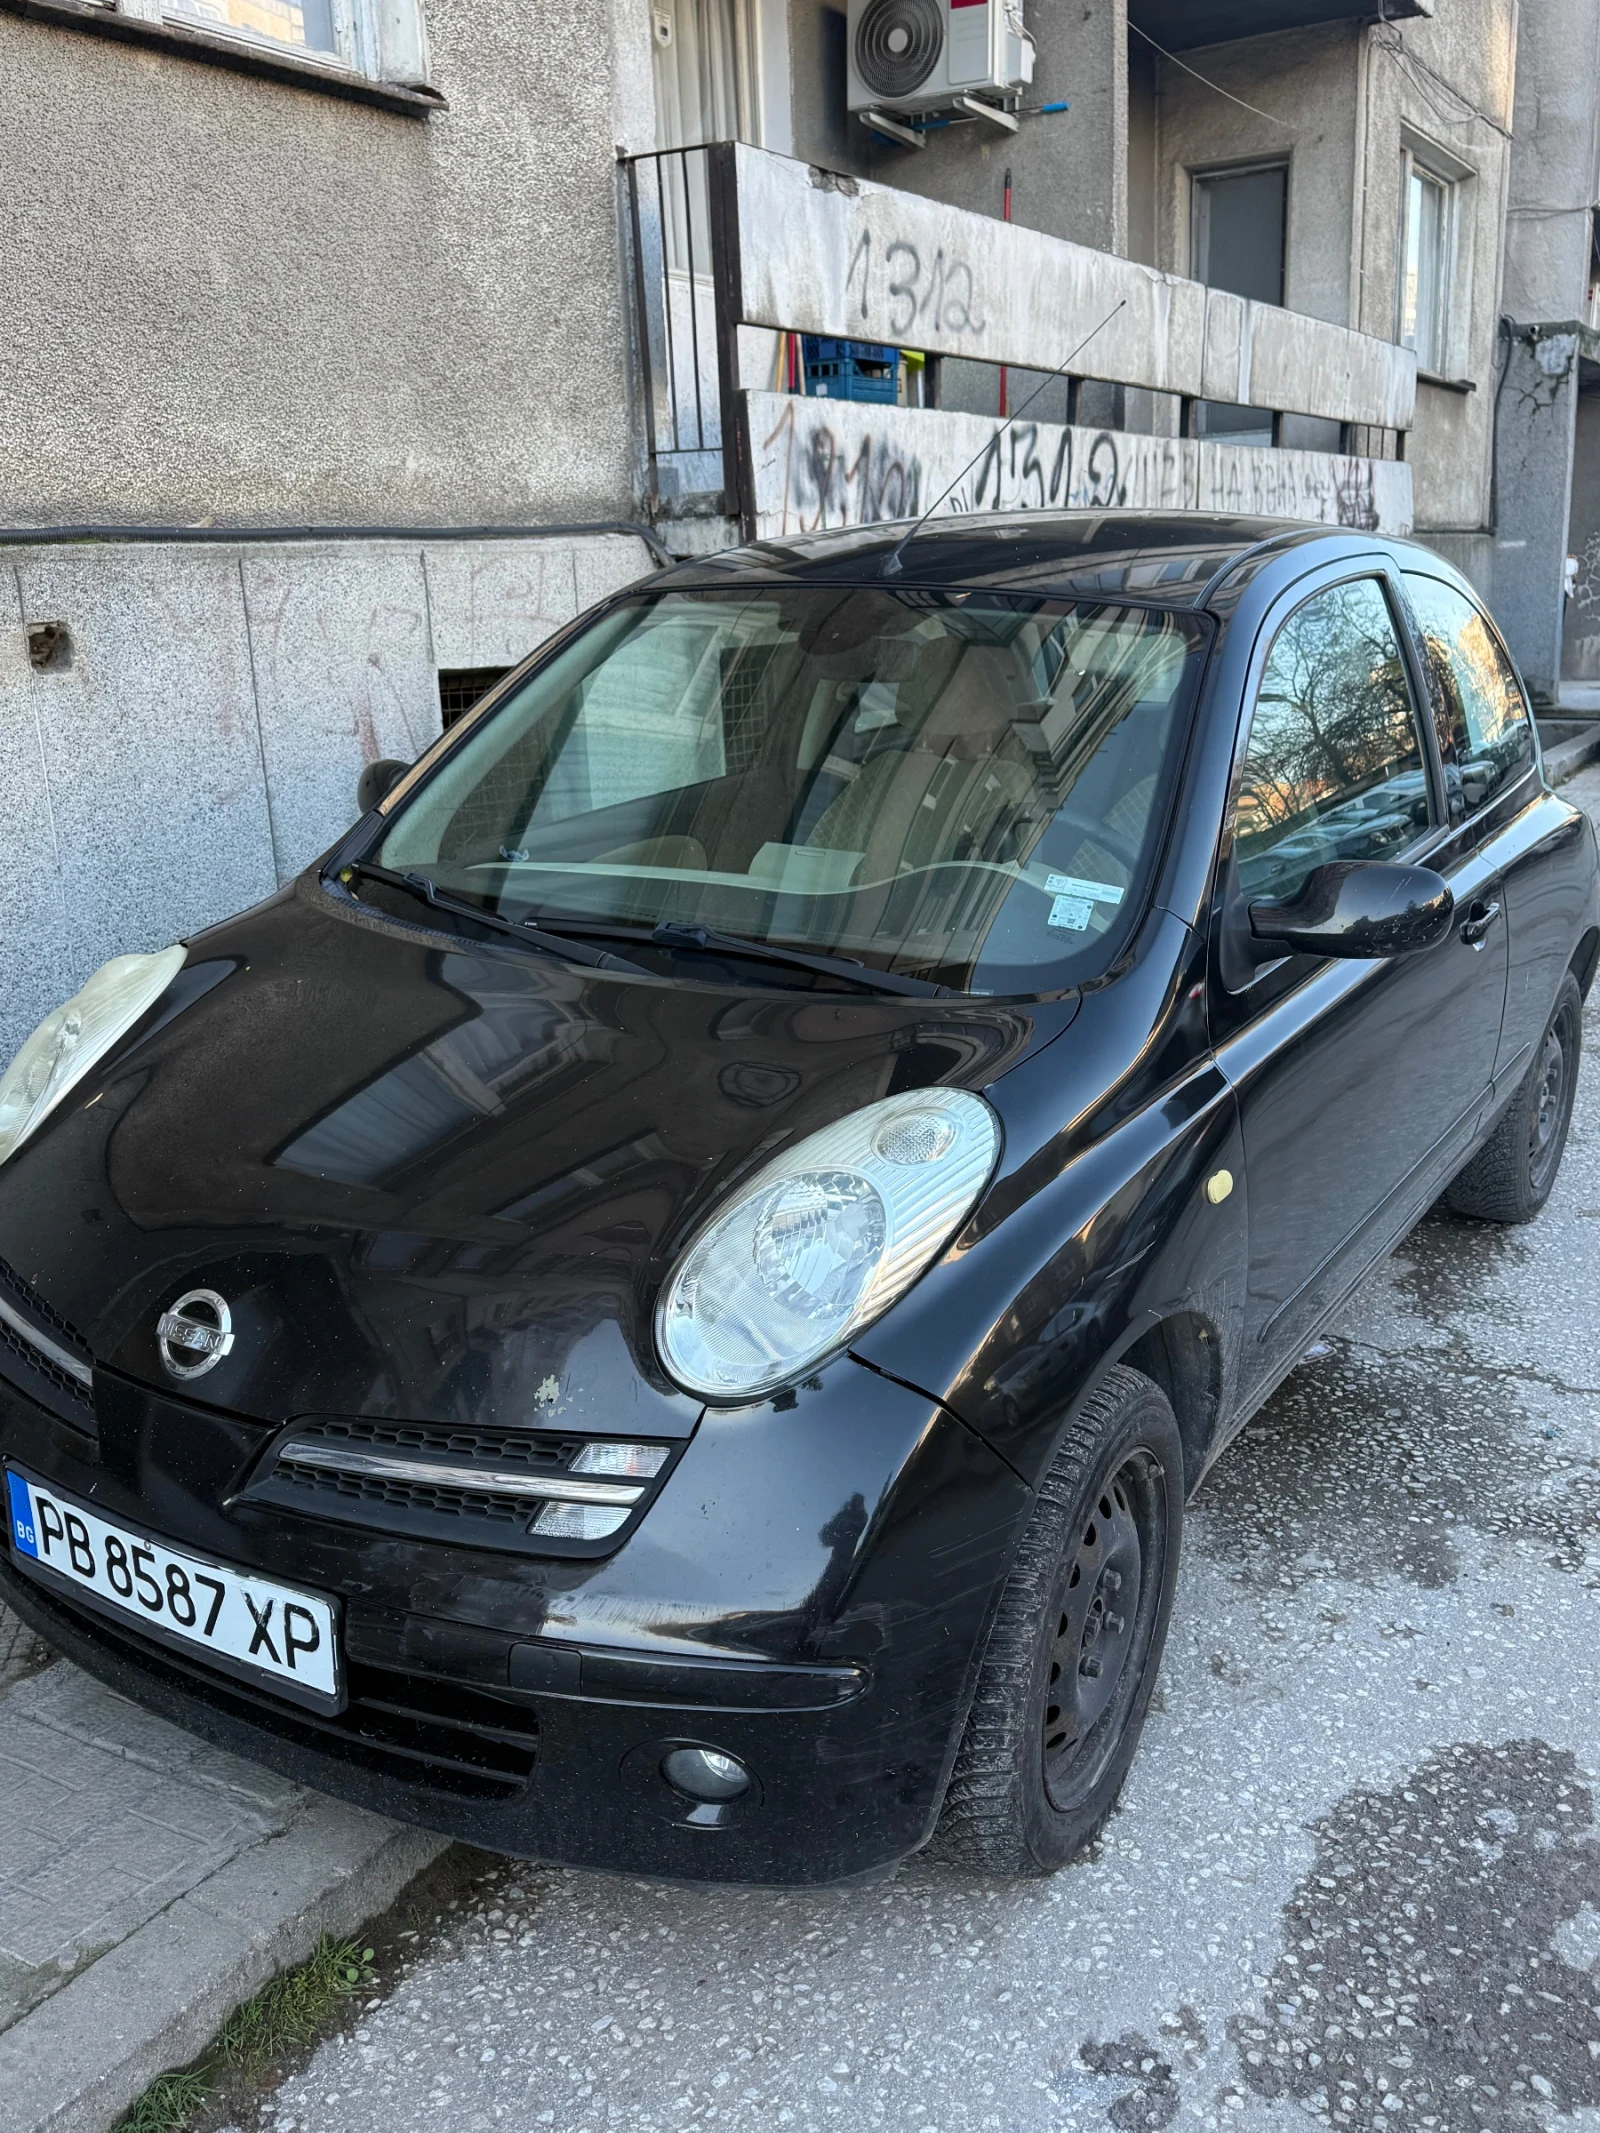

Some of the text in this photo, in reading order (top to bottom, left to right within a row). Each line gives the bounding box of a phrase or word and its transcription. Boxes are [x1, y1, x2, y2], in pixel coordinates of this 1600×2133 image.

[160, 1318, 221, 1349] NISSAN
[16, 1520, 35, 1544] BG
[35, 1495, 321, 1670] PB 8587 XP
